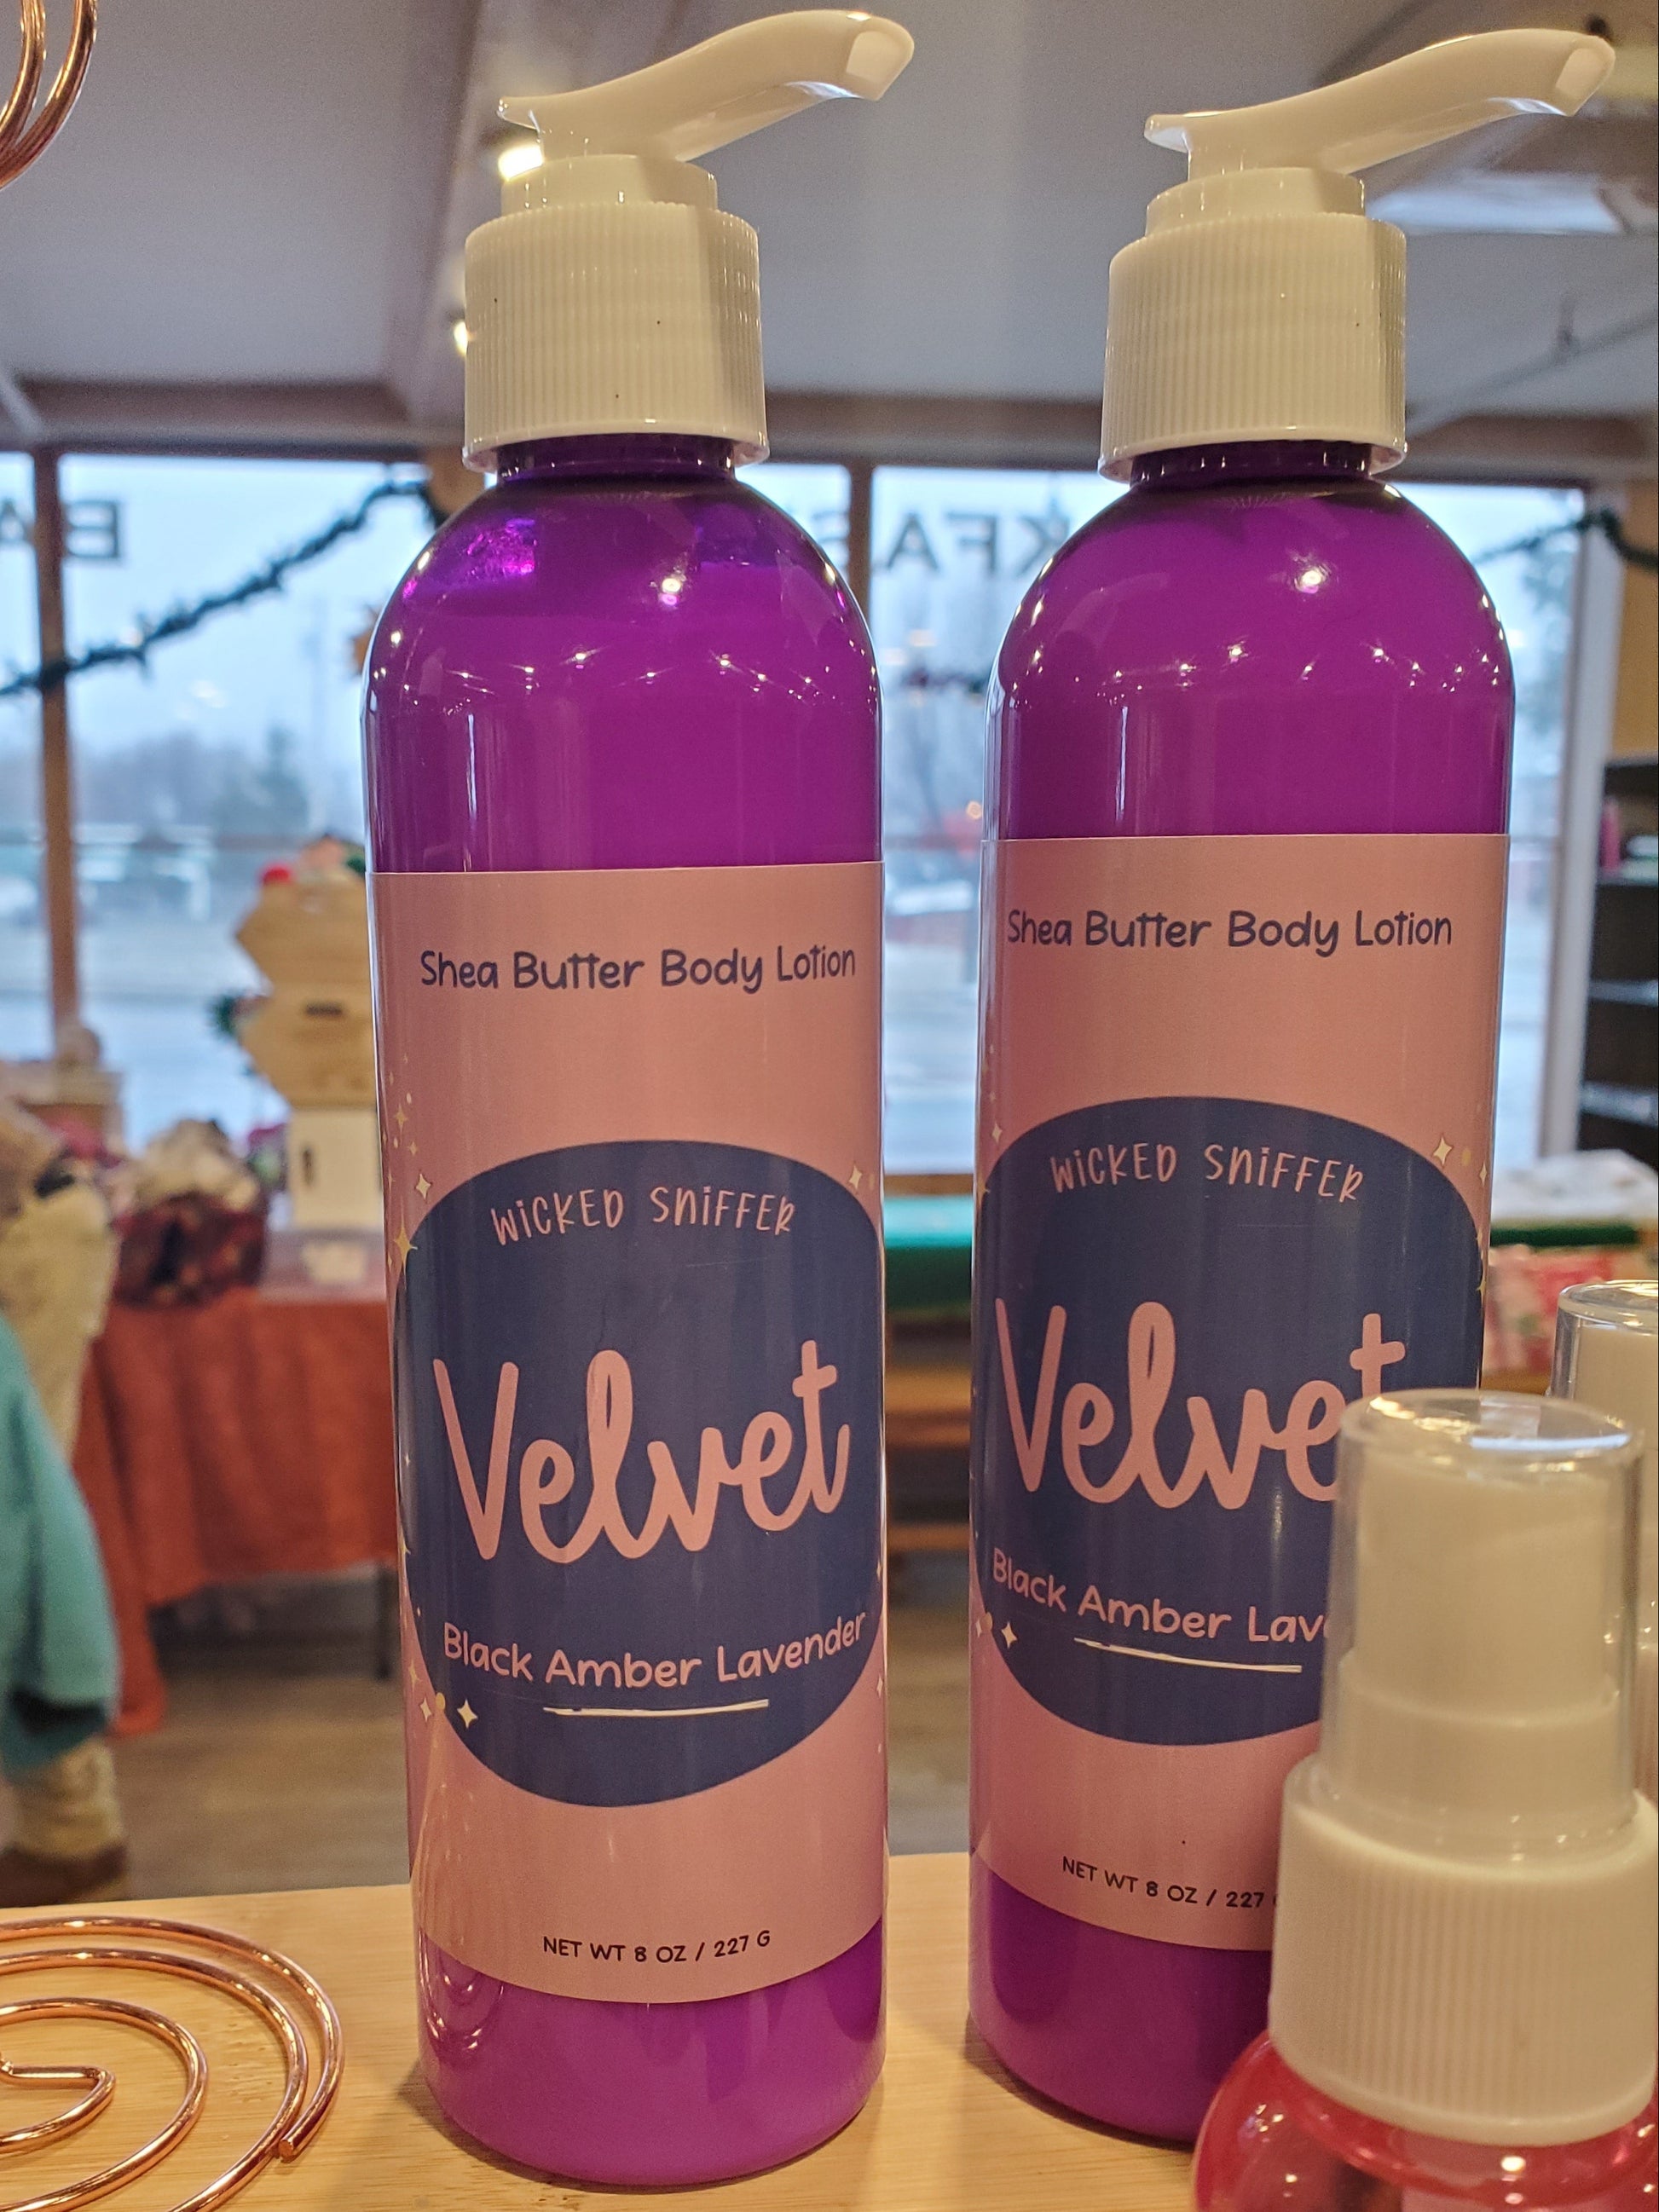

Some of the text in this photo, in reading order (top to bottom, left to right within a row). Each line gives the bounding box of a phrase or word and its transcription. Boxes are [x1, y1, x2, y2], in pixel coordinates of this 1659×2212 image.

[1008, 910, 1452, 958] Shea Butter Body Lotion
[420, 945, 856, 995] Shea Butter Body Lotion
[433, 1339, 850, 1563] Velvet
[992, 1547, 1330, 1643] Black Amber Lav
[444, 1612, 867, 1689] Black Amber Lavender
[1062, 1856, 1097, 1882] NET
[1105, 1869, 1138, 1893] WT
[1146, 1880, 1159, 1897] 8
[1167, 1885, 1198, 1904] OZ
[1205, 1889, 1217, 1907] /
[1226, 1891, 1264, 1908] 227
[543, 1930, 771, 1963] NET WT 8 OZ / 227 G
